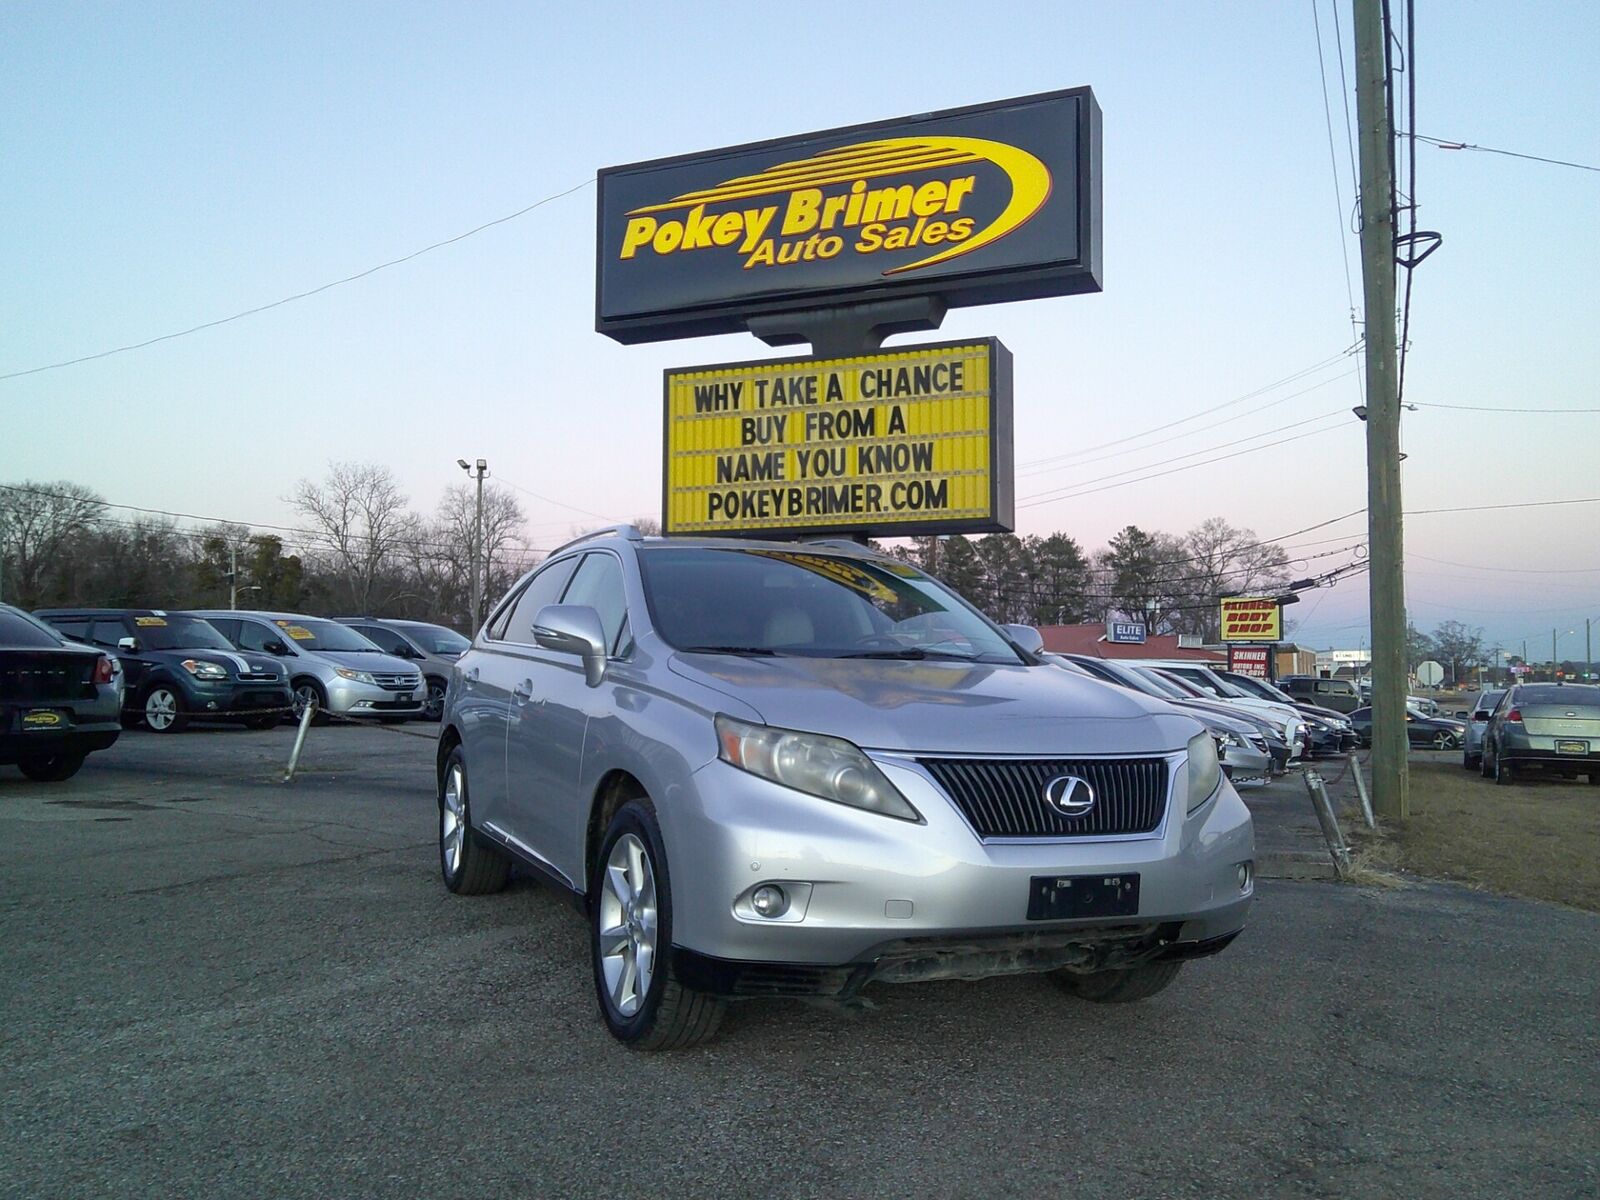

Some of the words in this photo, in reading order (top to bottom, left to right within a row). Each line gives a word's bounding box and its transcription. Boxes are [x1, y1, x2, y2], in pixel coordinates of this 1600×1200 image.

[620, 203, 778, 260] Pokey
[781, 175, 976, 237] Brimer
[744, 238, 843, 270] Auto
[855, 217, 976, 254] Sales
[694, 381, 743, 413] WHY
[755, 375, 818, 408] TAKE
[825, 373, 843, 403] A
[860, 361, 963, 399] CHANCE
[741, 414, 787, 446] BUY
[805, 408, 875, 442] FROM
[888, 406, 906, 435] A
[716, 452, 786, 484] NAME
[797, 447, 846, 478] YOU
[858, 442, 934, 475] KNOW
[708, 479, 948, 520] POKEYBRIMER.COM
[1117, 625, 1141, 634] ELITE
[1227, 613, 1271, 621] BODY
[1228, 624, 1273, 632] SHOP
[1233, 651, 1266, 660] SKINNER
